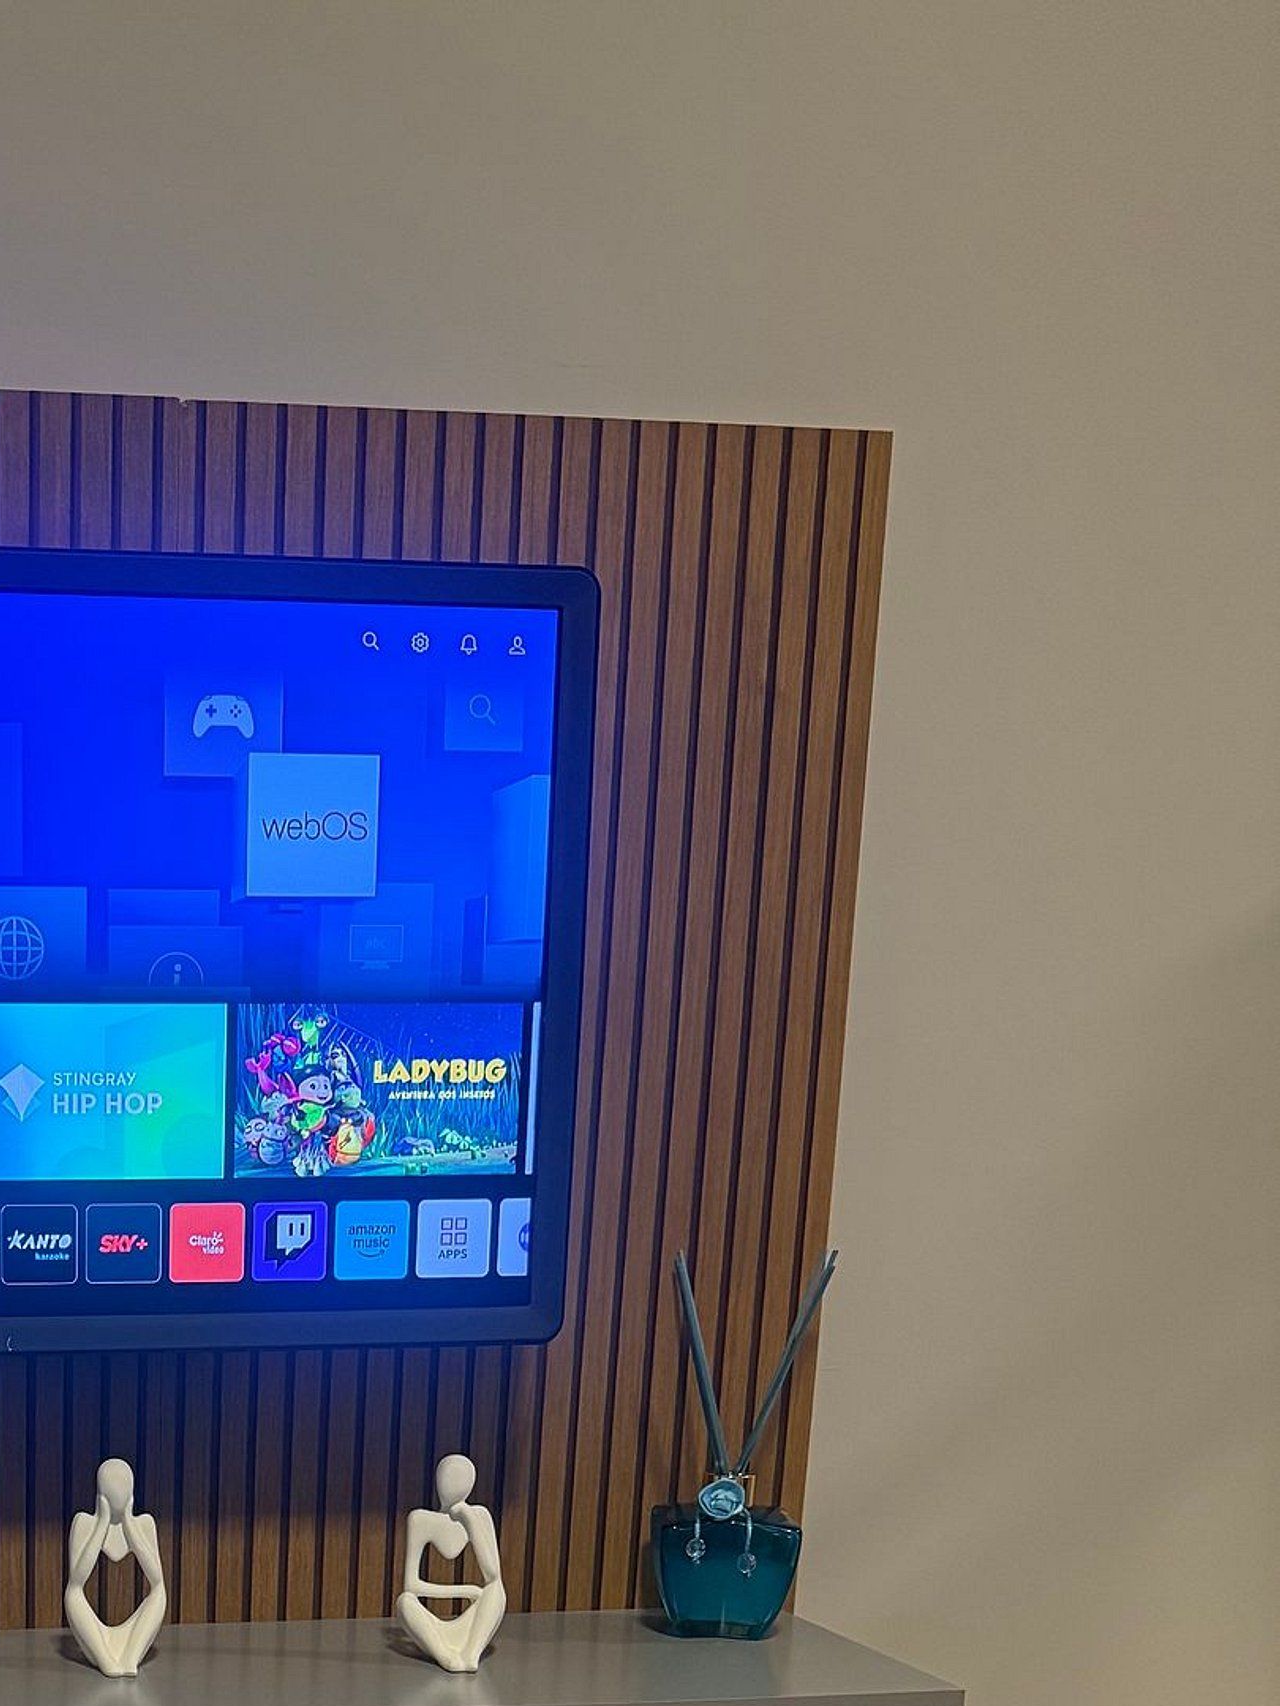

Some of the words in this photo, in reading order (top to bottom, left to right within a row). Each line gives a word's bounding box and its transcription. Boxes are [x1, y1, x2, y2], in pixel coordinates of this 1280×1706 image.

[262, 811, 369, 841] webOS
[53, 1072, 137, 1087] STINGRAY
[373, 1057, 507, 1084] LADYBUG
[53, 1092, 97, 1115] HIP
[105, 1092, 163, 1115] HOP
[8, 1229, 72, 1250] KANTO
[348, 1225, 396, 1236] amazon
[99, 1234, 149, 1252] SKY+
[353, 1237, 390, 1248] music
[438, 1249, 468, 1260] APPS
